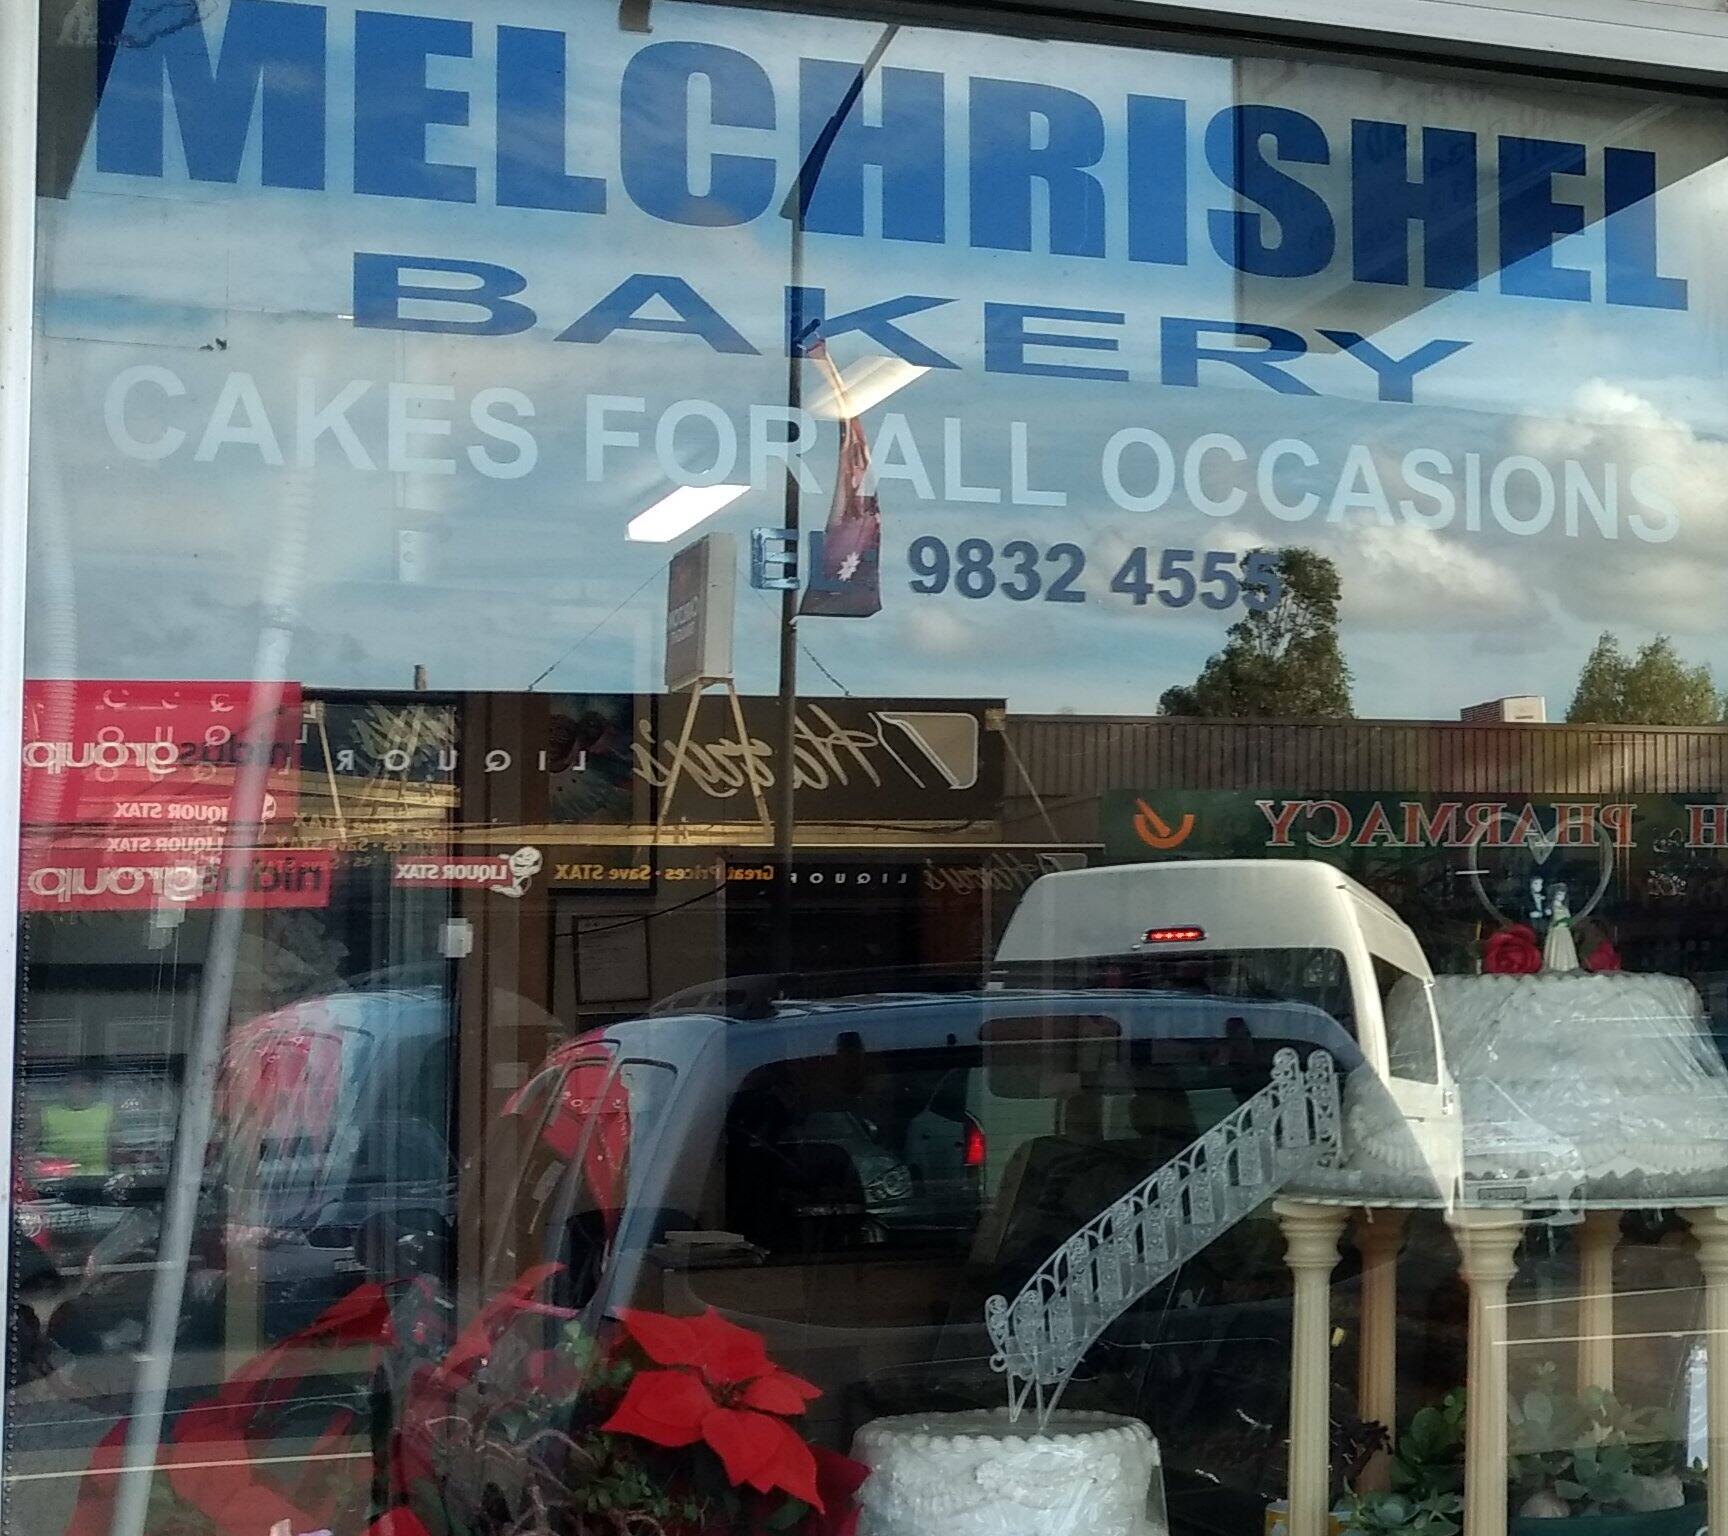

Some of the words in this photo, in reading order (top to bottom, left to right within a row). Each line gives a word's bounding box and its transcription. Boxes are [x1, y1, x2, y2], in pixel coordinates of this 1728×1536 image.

[353, 251, 1474, 404] BAKERY
[104, 365, 539, 480] CAKES
[586, 394, 824, 496] FOR
[858, 413, 1068, 507] ALL
[1101, 426, 1682, 544] OCCASIONS
[907, 535, 1087, 603] 9832
[1111, 546, 1283, 611] 4555
